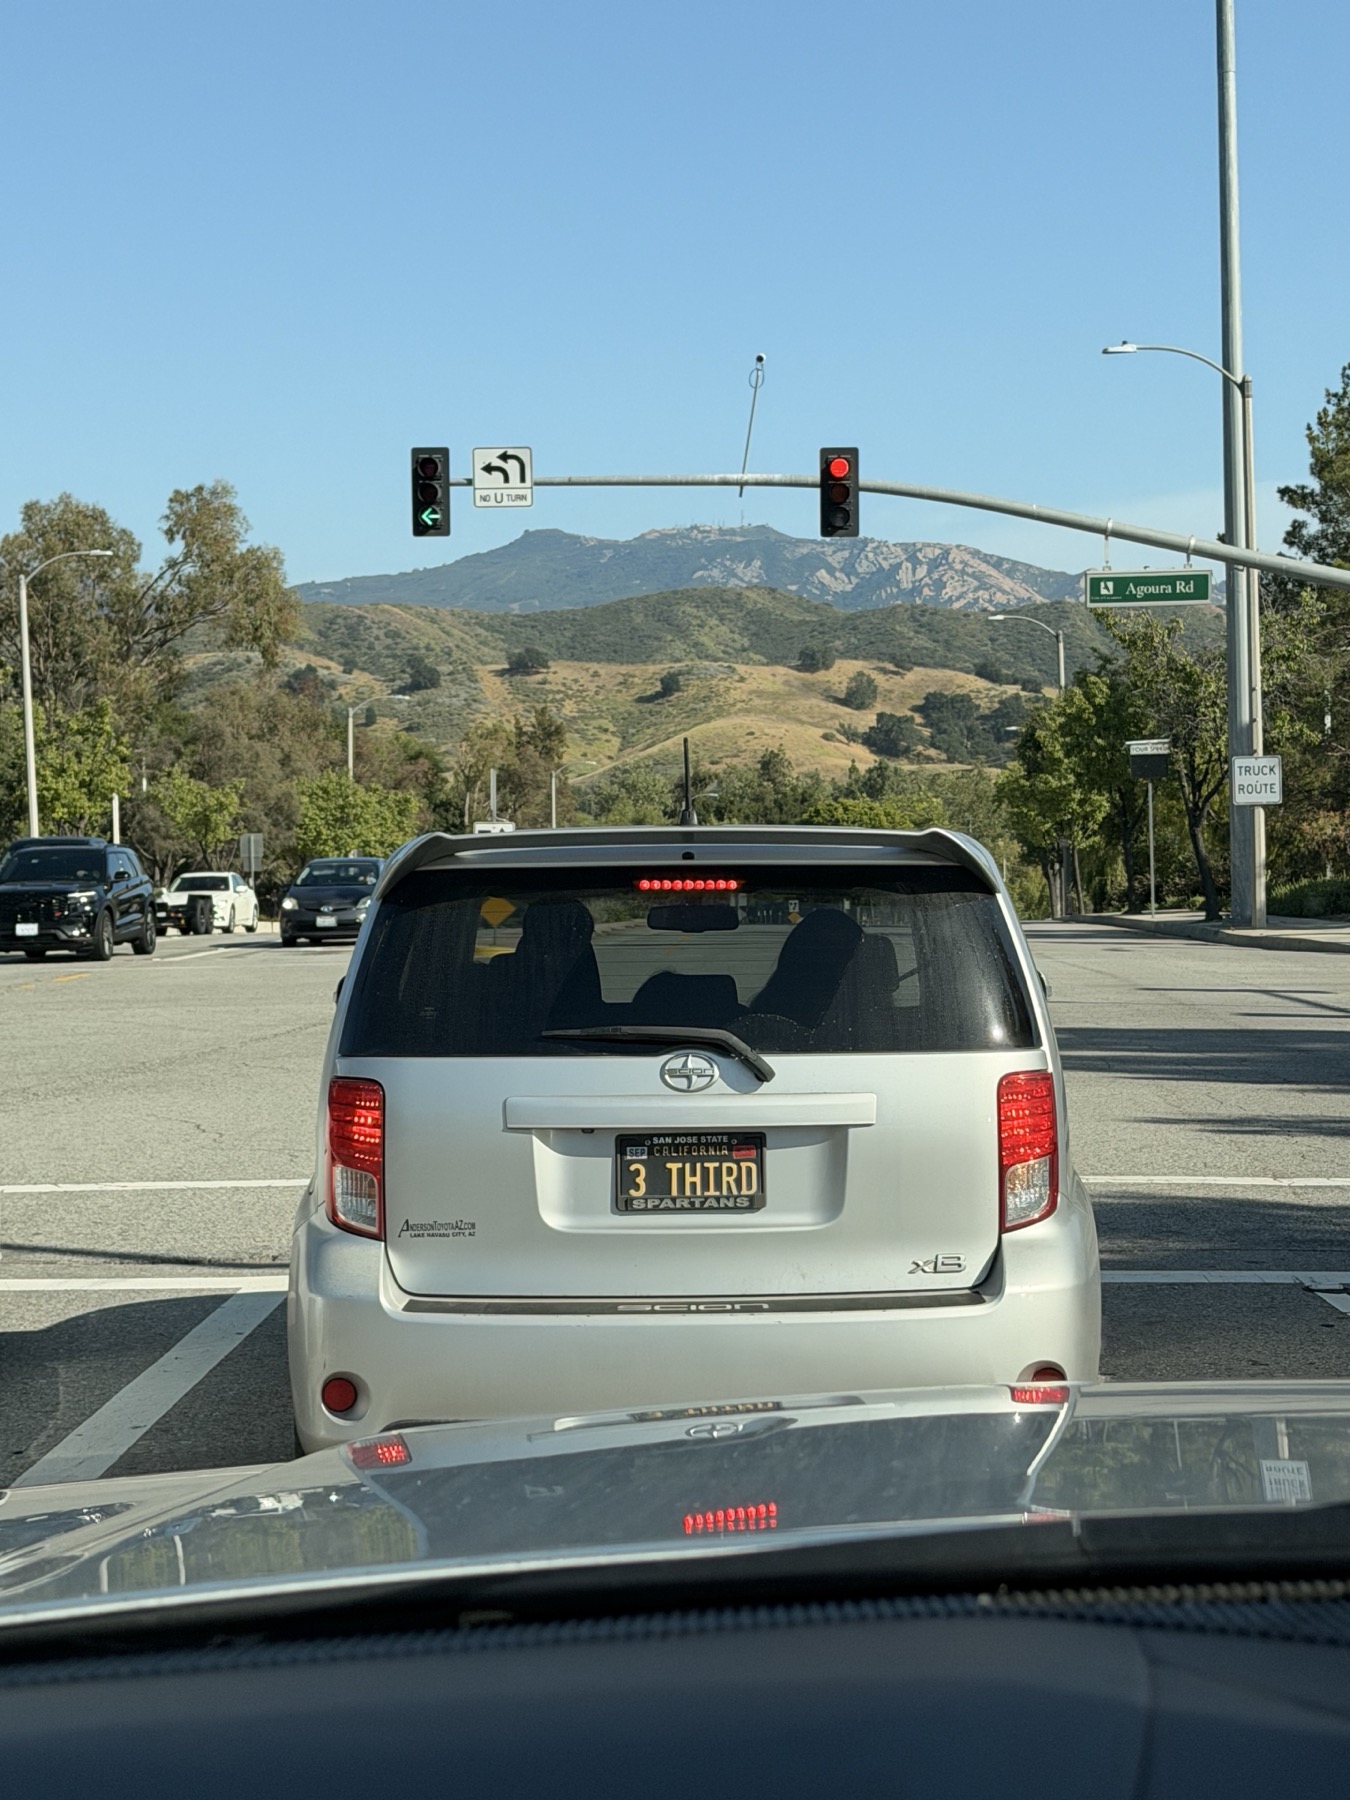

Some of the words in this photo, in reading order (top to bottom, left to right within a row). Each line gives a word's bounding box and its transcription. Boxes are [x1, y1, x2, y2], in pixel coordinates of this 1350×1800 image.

[480, 494, 491, 502] NO
[494, 492, 504, 504] U
[506, 493, 528, 502] TURN
[1125, 582, 1172, 599] Agoura
[1176, 580, 1194, 594] Rd
[1236, 765, 1276, 776] TRUCK
[1237, 783, 1277, 795] ROUTE
[652, 1136, 672, 1145] SAN
[674, 1135, 698, 1144] JOSE
[700, 1135, 729, 1144] STATE
[628, 1147, 646, 1157] SEP
[653, 1145, 728, 1157] CALIFORNIA
[628, 1162, 647, 1198] 3
[665, 1161, 758, 1197] THIRD
[632, 1196, 750, 1210] SPARTANS
